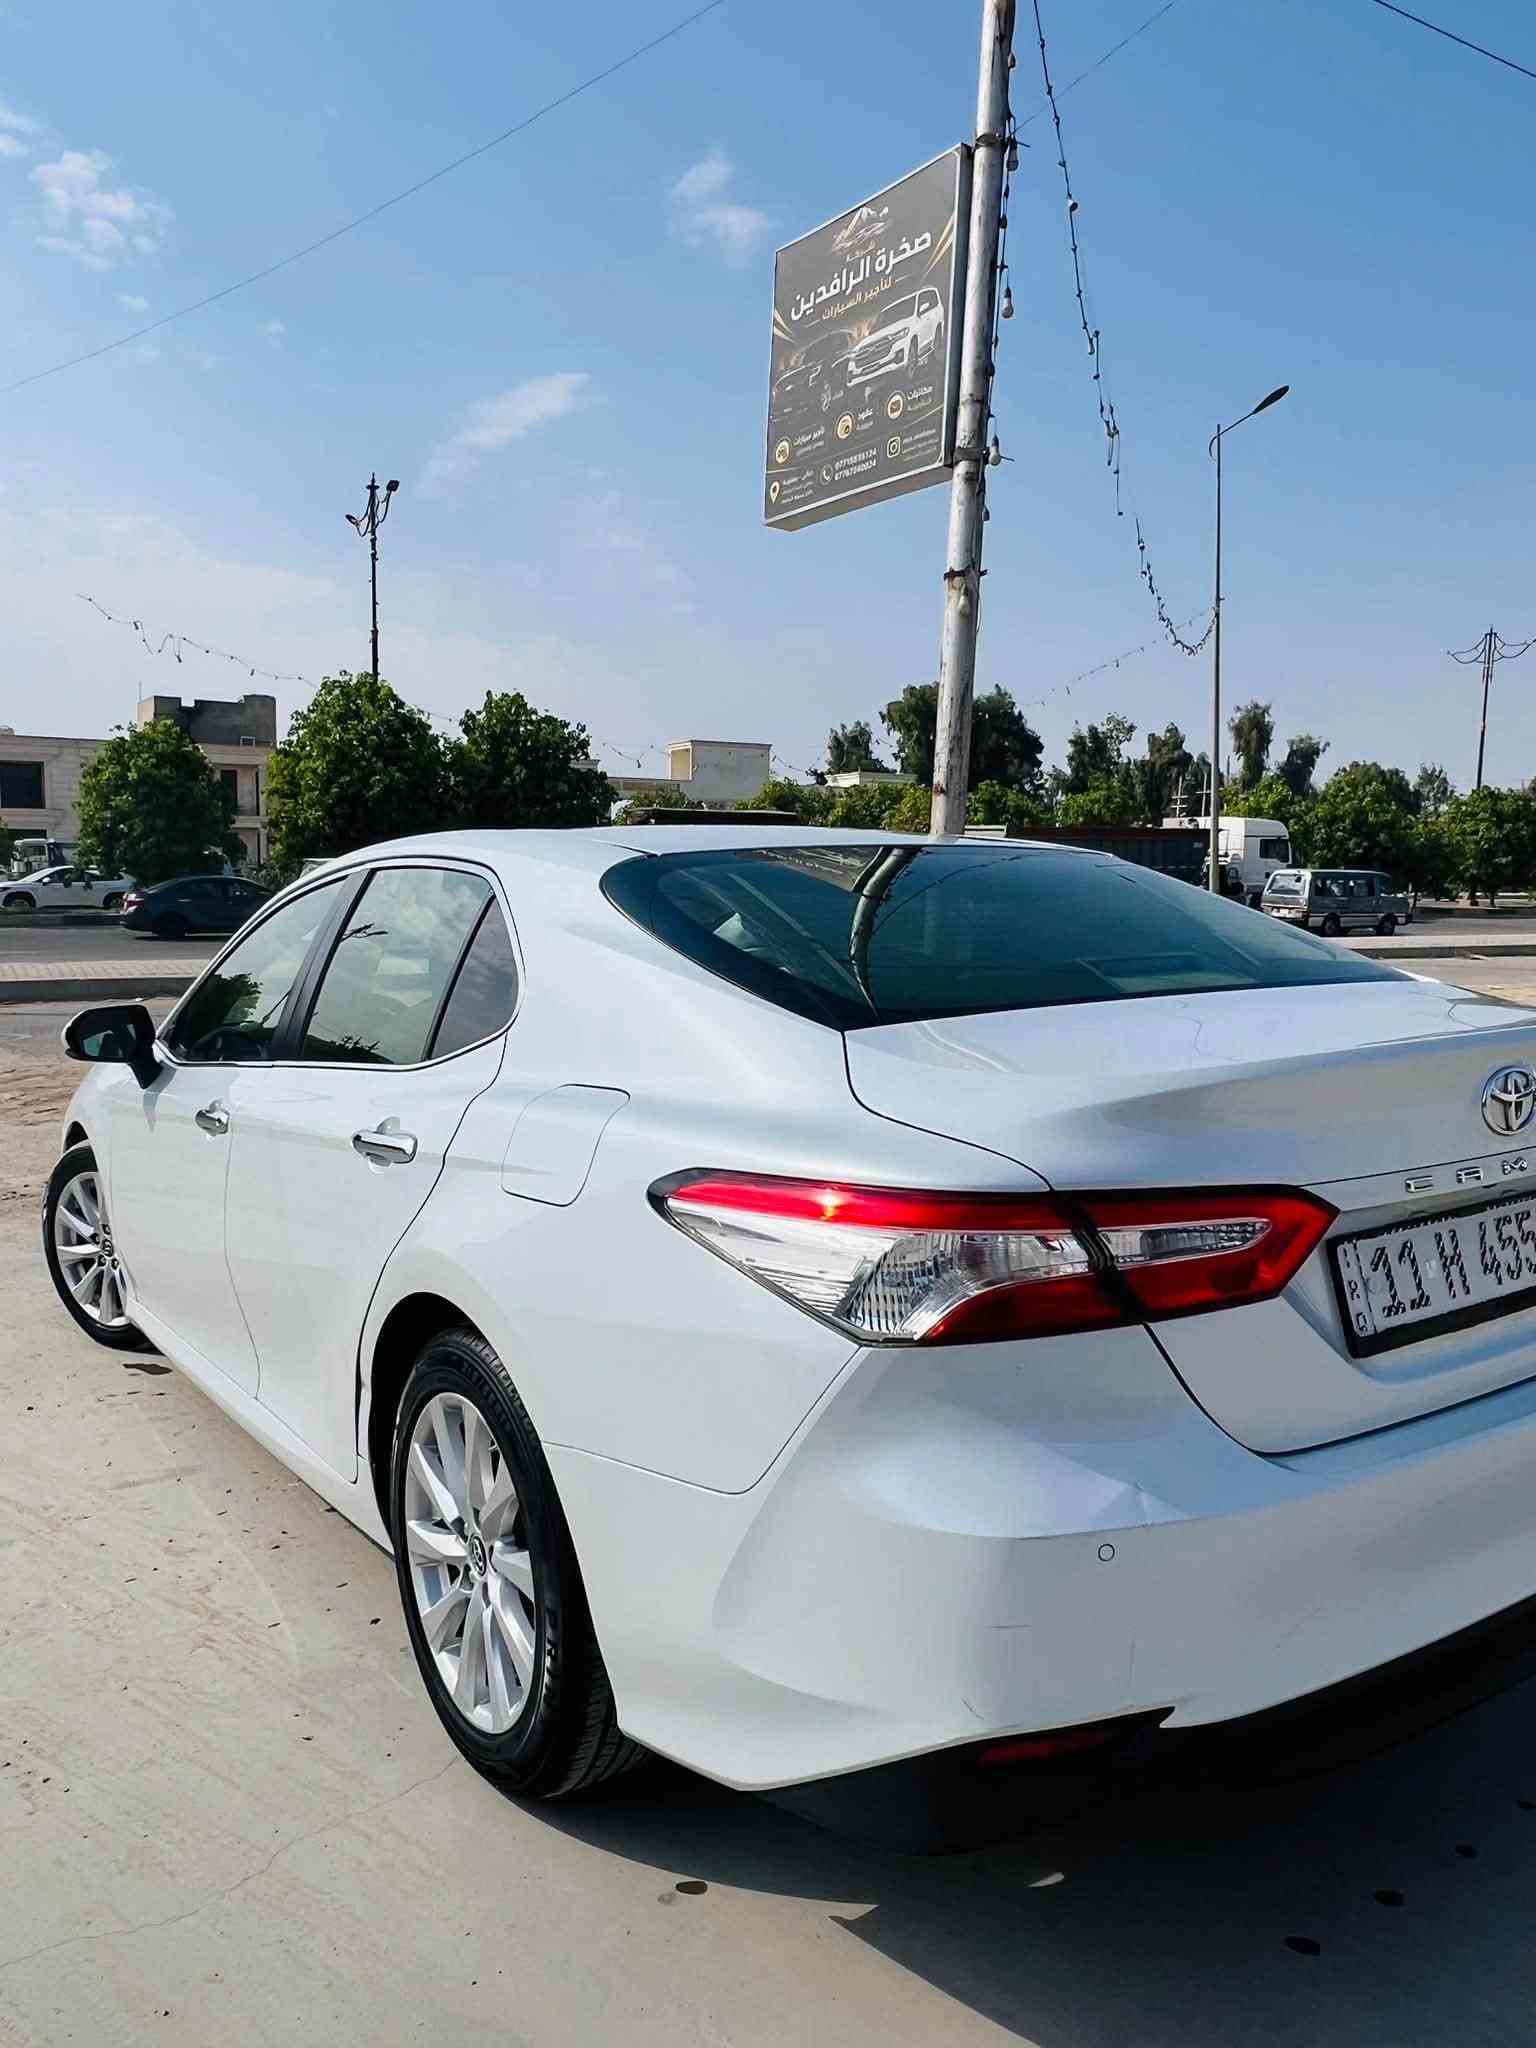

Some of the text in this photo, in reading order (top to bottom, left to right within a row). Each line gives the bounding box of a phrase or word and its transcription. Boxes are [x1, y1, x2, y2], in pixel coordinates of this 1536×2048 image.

[791, 231, 932, 321] صخرة الرافدين
[1370, 1239, 1432, 1318] 11
